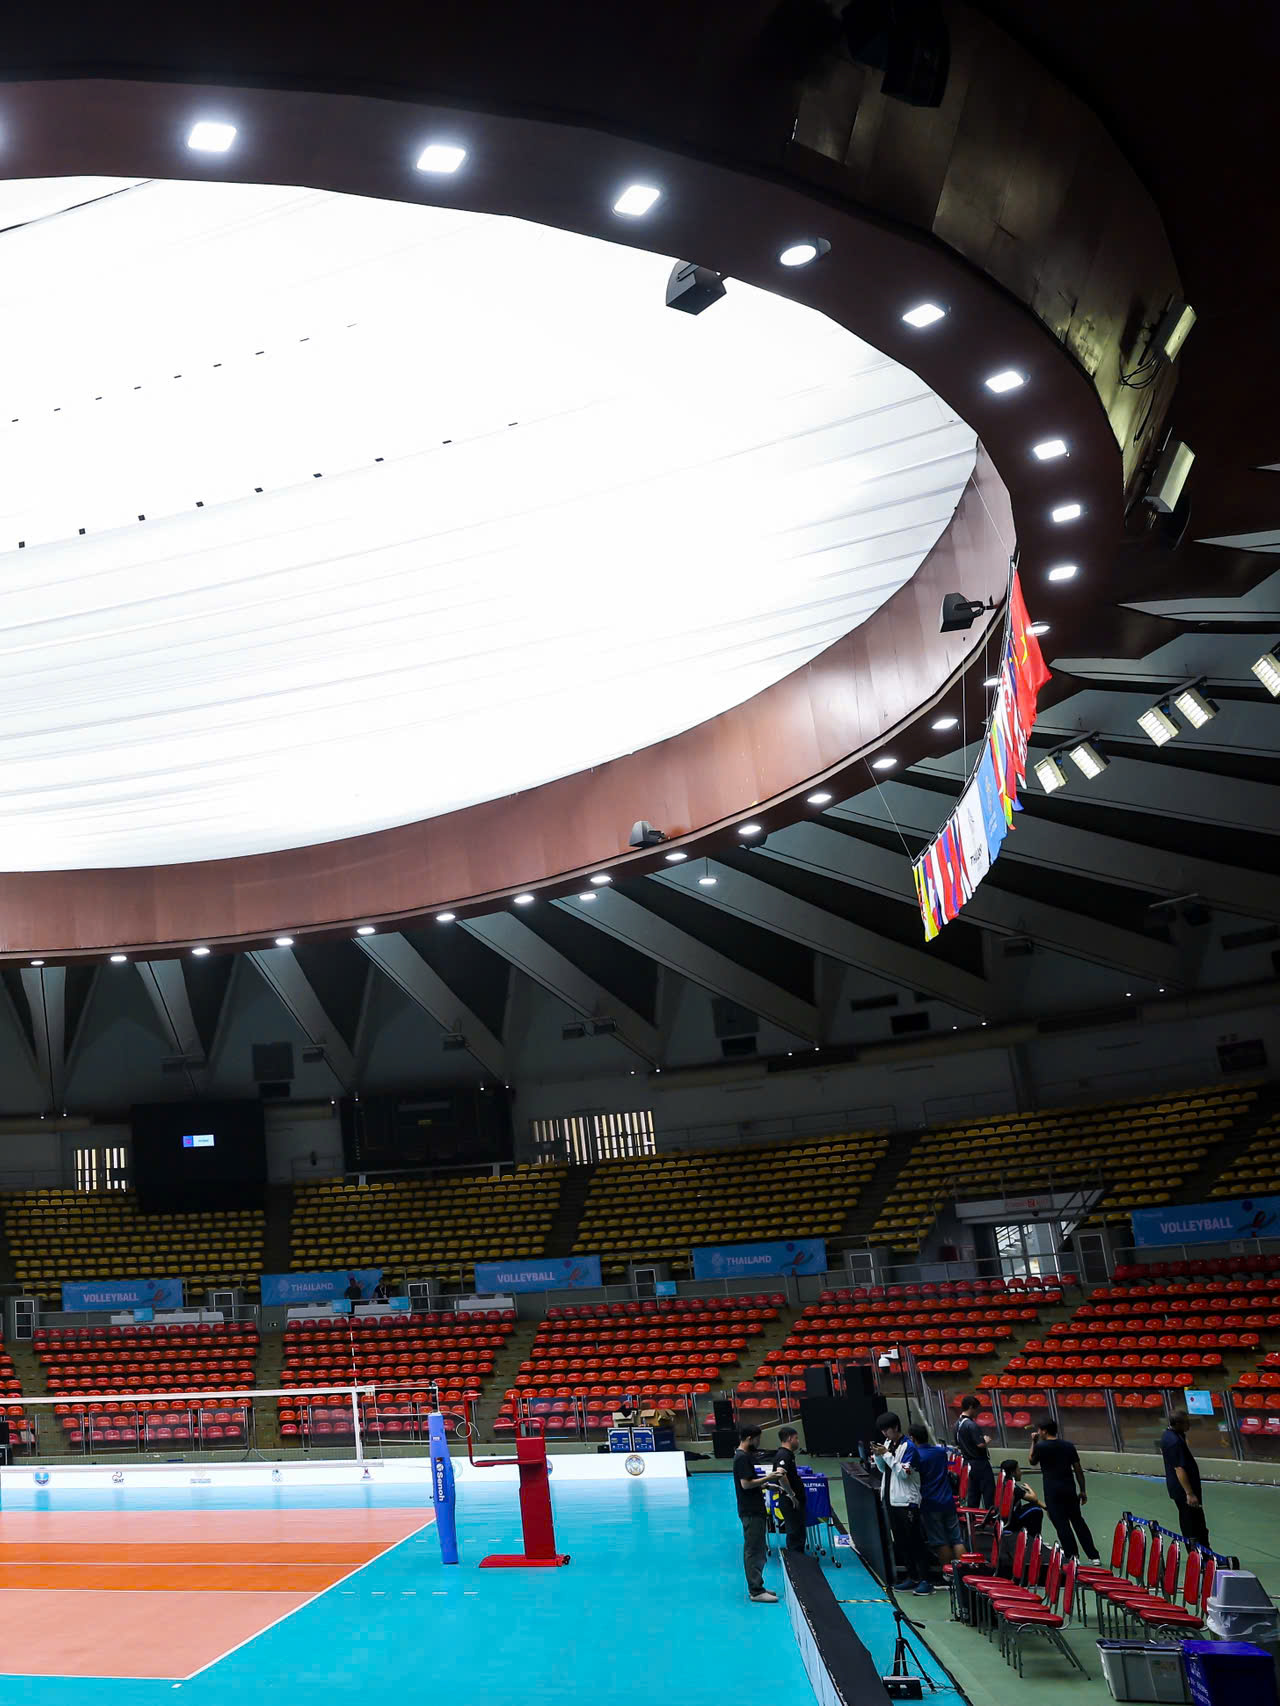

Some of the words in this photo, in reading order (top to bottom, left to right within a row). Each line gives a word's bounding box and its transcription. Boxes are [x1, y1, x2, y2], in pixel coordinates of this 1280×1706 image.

[1160, 1216, 1233, 1234] VOLLEYBALL
[727, 1255, 772, 1266] THAILAND
[496, 1271, 556, 1283] VOLLEYBALL
[291, 1281, 335, 1292] THAILAND
[82, 1292, 140, 1304] VOLLEYBALL
[436, 1471, 446, 1502] Senoh
